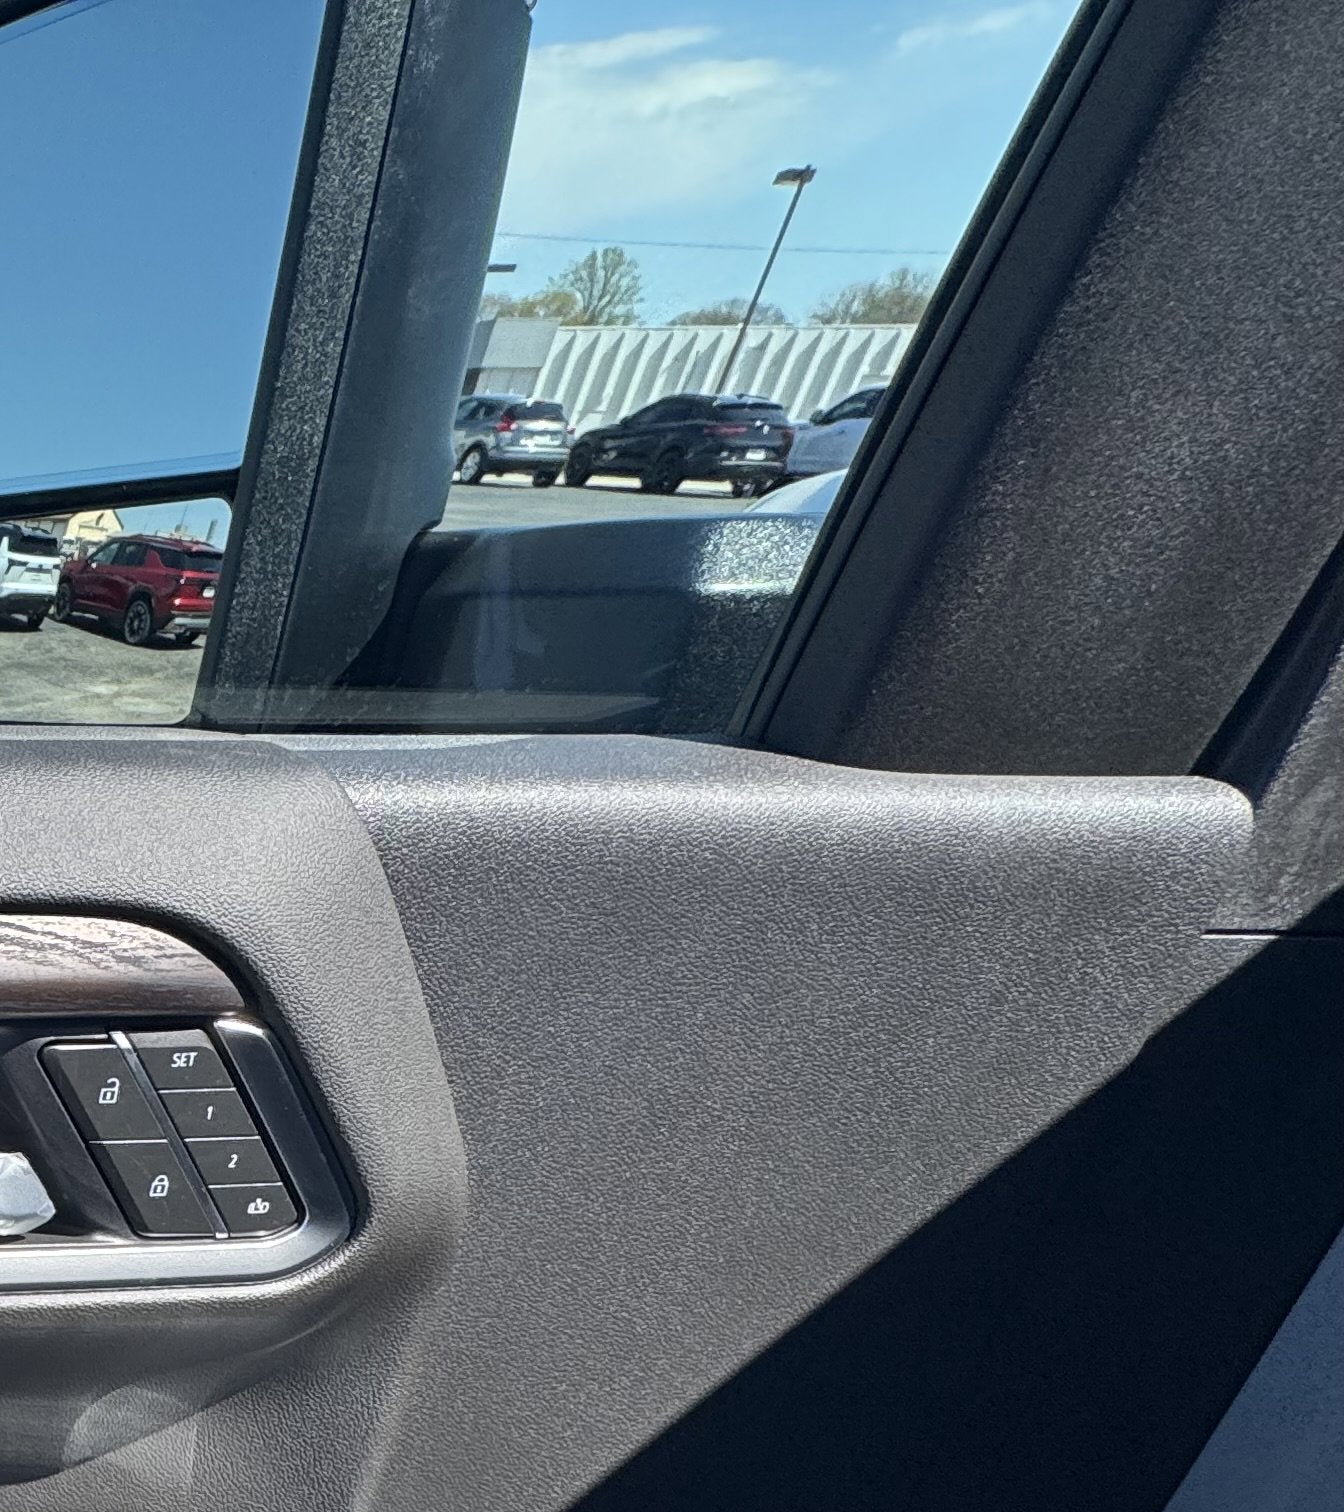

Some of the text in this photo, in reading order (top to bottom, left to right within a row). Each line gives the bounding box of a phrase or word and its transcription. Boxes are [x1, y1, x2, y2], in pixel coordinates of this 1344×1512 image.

[171, 1051, 198, 1068] SET
[207, 1105, 214, 1120] 1
[227, 1153, 238, 1169] 2
